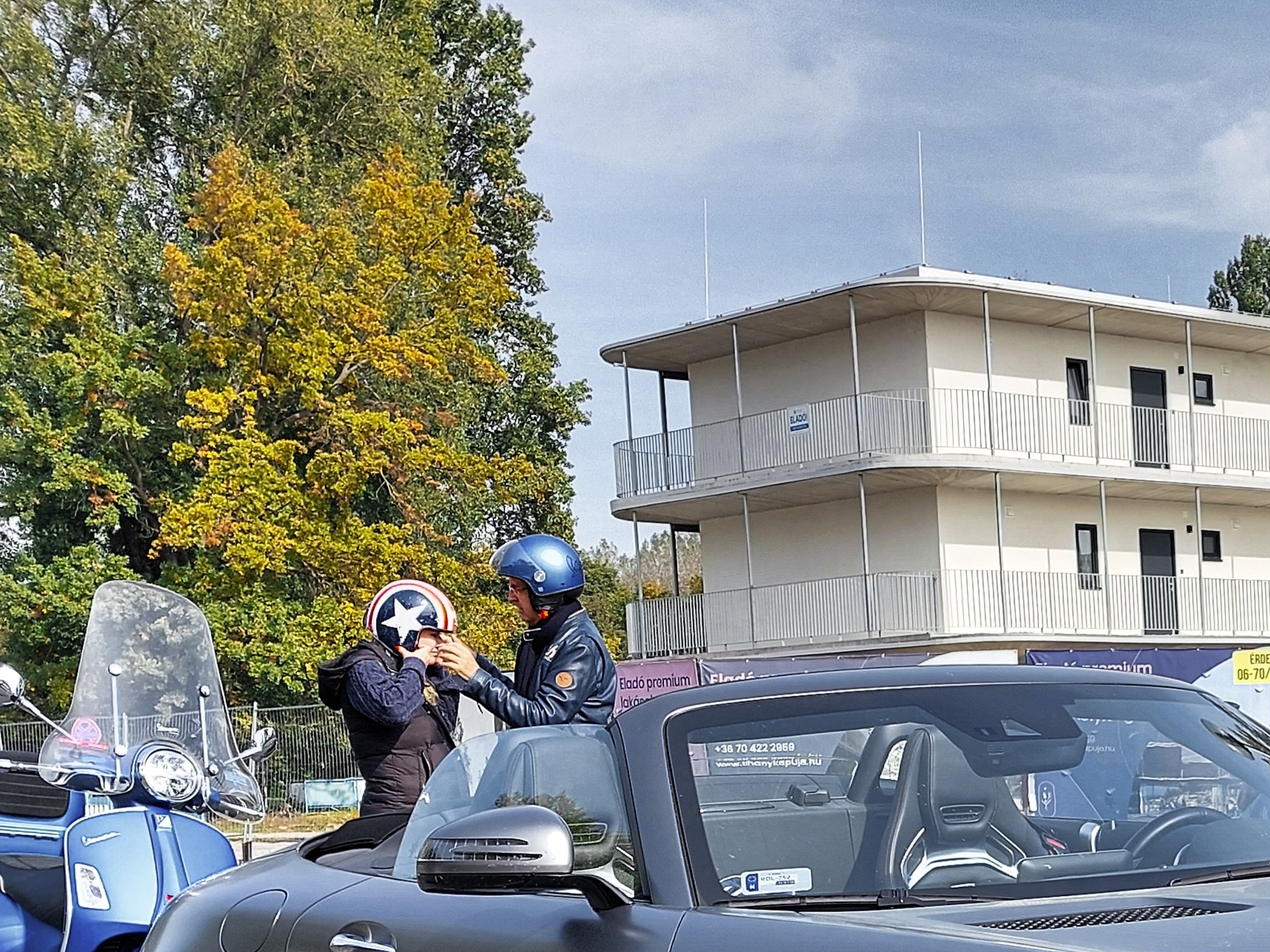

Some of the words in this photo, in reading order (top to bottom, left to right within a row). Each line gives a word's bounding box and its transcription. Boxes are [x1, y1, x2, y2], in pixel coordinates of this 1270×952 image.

[619, 675, 645, 690] Eladó
[646, 673, 691, 692] premium
[735, 743, 748, 753] 70
[749, 743, 768, 753] 422
